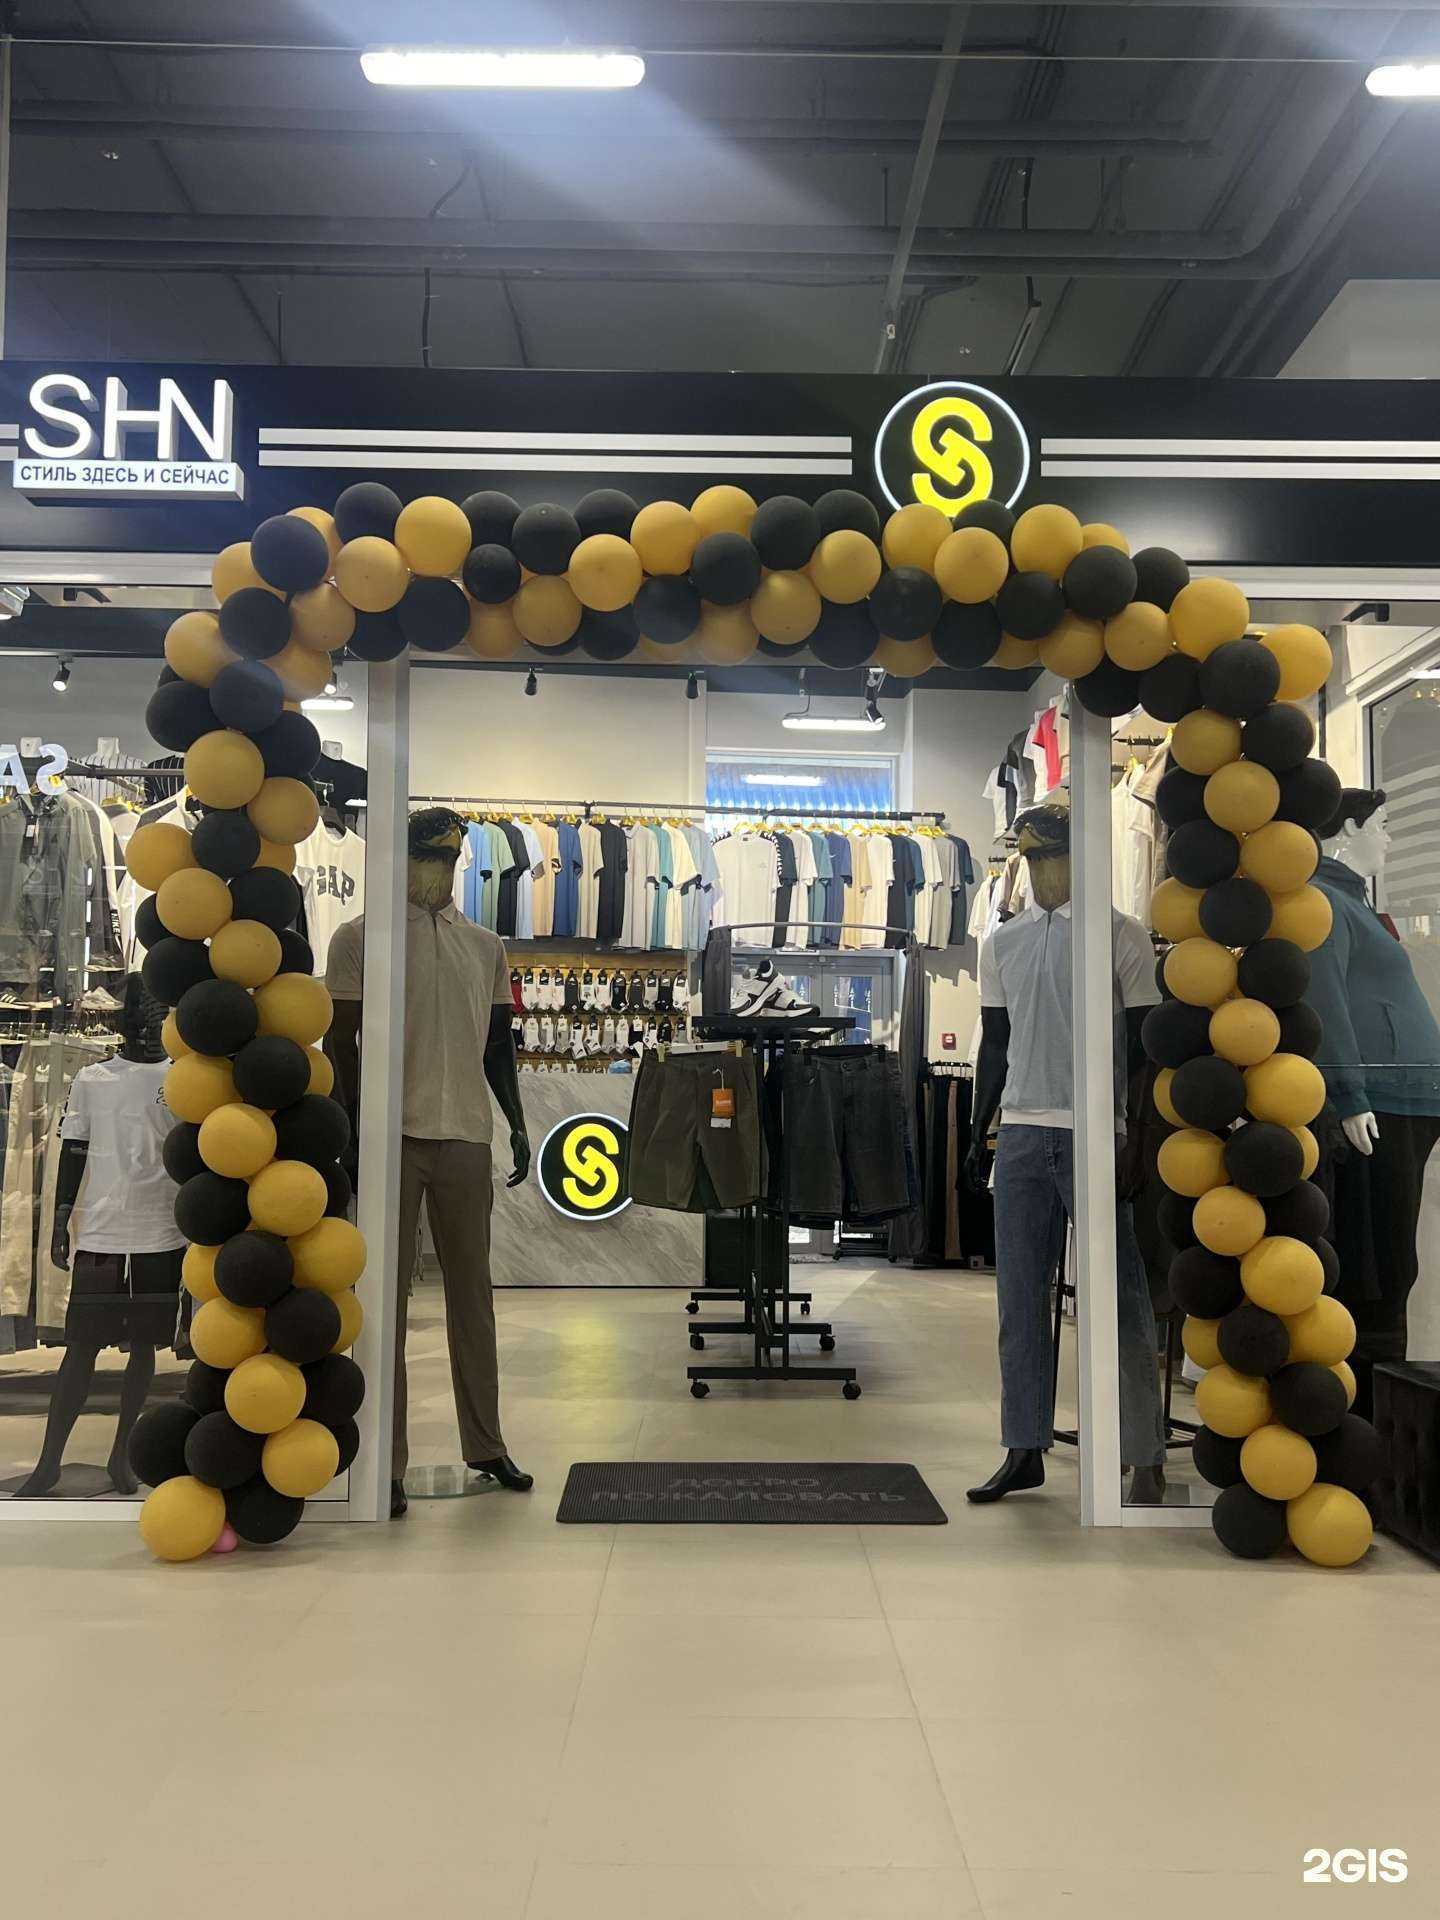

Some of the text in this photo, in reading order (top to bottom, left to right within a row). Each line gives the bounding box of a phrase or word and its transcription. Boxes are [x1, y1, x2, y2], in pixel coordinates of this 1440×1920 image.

[24, 373, 234, 463] SHN
[20, 465, 230, 485] СТИЛЬ ЗДЕСЬ И СЕЙЧАС
[668, 1477, 820, 1489] ДОБРО
[591, 1490, 907, 1503] ПОЖАЛОВАТЬ
